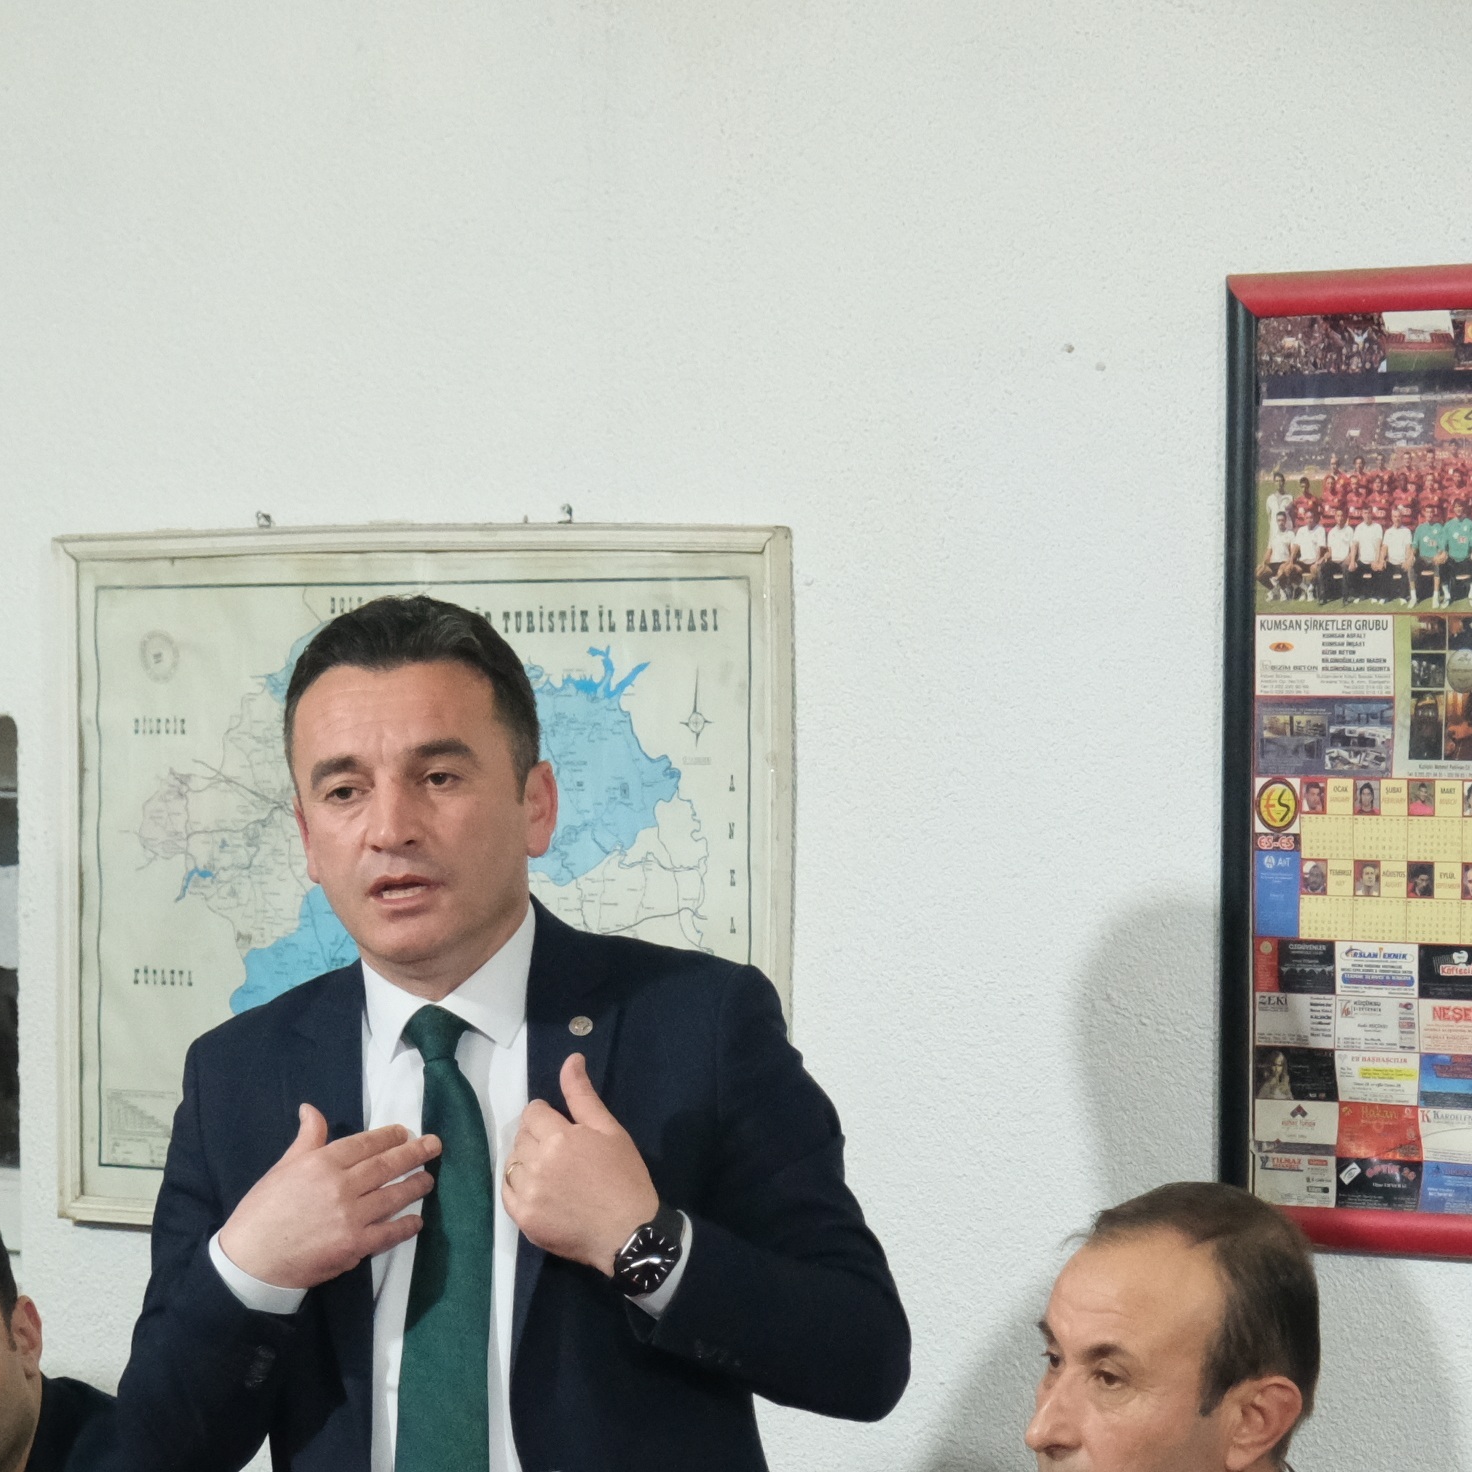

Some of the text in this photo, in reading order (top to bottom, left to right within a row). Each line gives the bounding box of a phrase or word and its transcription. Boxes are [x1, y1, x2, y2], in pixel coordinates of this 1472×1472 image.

[502, 605, 589, 633] TURİSTİK
[598, 605, 616, 632] İL
[626, 604, 719, 632] HARİTASI
[1260, 617, 1388, 634] KUMSAN ŞİRKETLER GRUBU
